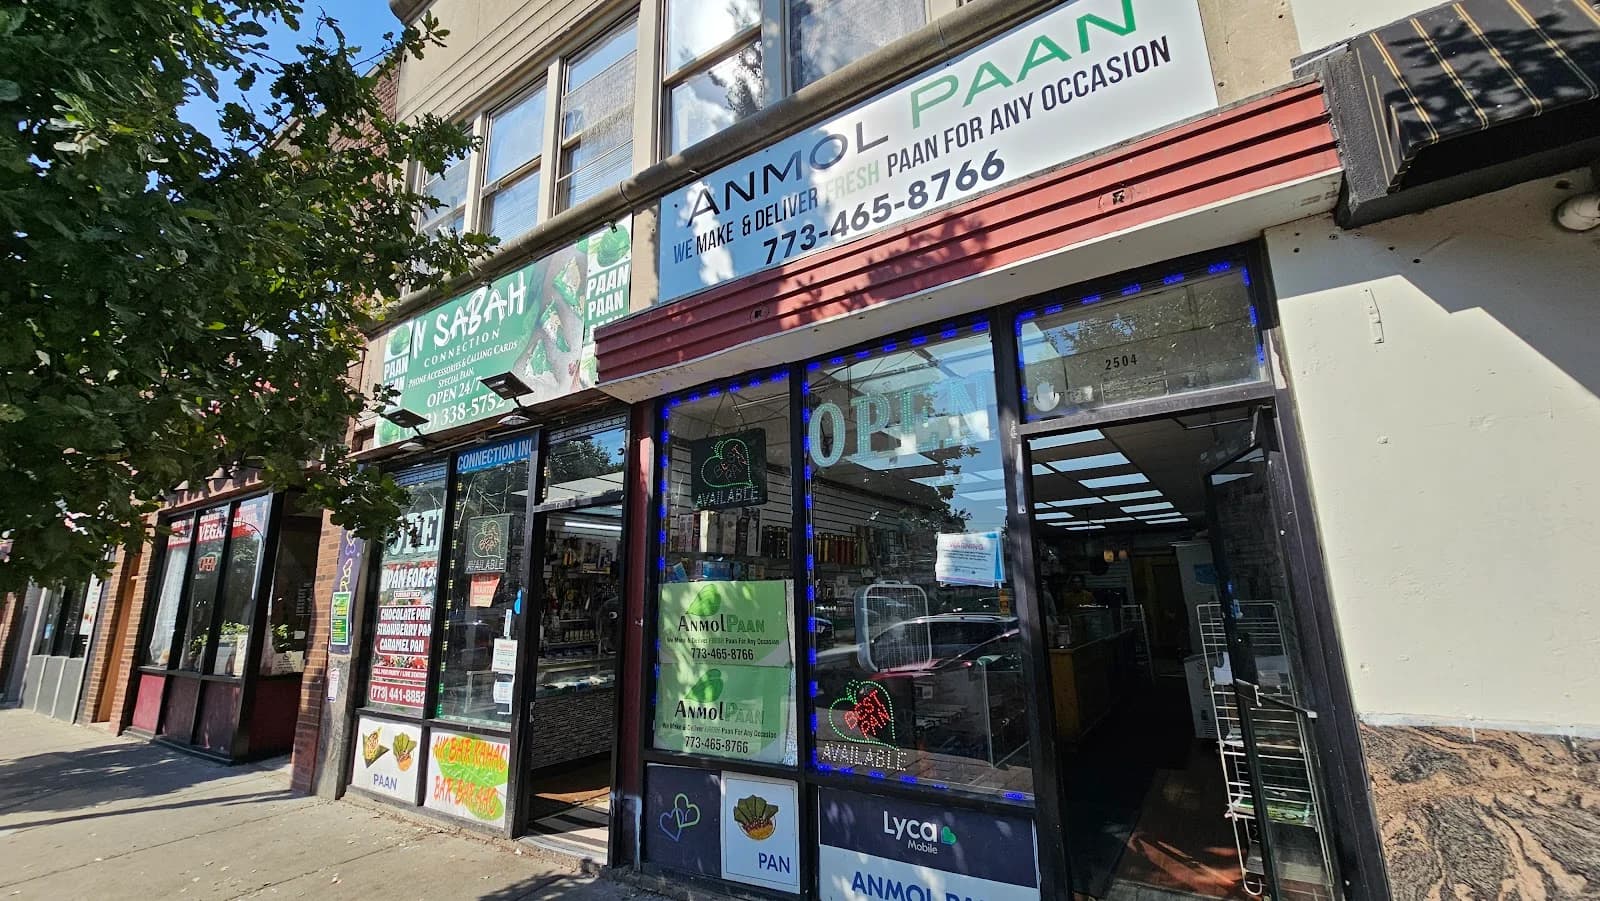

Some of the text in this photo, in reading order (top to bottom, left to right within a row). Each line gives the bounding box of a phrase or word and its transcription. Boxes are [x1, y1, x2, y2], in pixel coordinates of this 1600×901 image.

[687, 0, 1137, 227] ANMOL PAAN
[673, 35, 1172, 264] WE MAKE & DELIVER FRESH PAAN FOR ANY OCCASION
[763, 149, 1006, 265] 773-465-8766
[586, 263, 630, 300] PAAN
[433, 270, 527, 348] SABAH
[588, 290, 624, 321] PAAN
[423, 328, 500, 367] CONNECTION
[383, 355, 409, 381] PAAN
[408, 374, 428, 389] PHONE
[427, 361, 462, 381] ACCESSORIES
[466, 347, 493, 364] CALLING
[494, 341, 518, 356] CARDS
[1104, 353, 1138, 371] 2504
[427, 386, 457, 408] OPEN
[458, 375, 483, 398] 24/7
[808, 370, 990, 468] OPEN
[456, 442, 516, 471] CONNECTION
[696, 485, 759, 508] AVAILABLE
[381, 608, 431, 621] CHOCOLATE PAN
[377, 623, 418, 636] STRAWBERRY
[747, 638, 757, 646] Any
[380, 638, 424, 653] CARAMEL PAN
[691, 648, 754, 660] 773-465-8766
[371, 685, 388, 702] (773)
[685, 735, 749, 753] 773-465-8766
[721, 727, 734, 735] Paan
[734, 728, 743, 736] For
[743, 729, 754, 739] Any
[821, 742, 907, 772] AVAILABLE
[373, 773, 398, 791] PAAN
[883, 810, 938, 843] Lyca
[907, 839, 938, 855] Mobile
[758, 851, 791, 875] PAN
